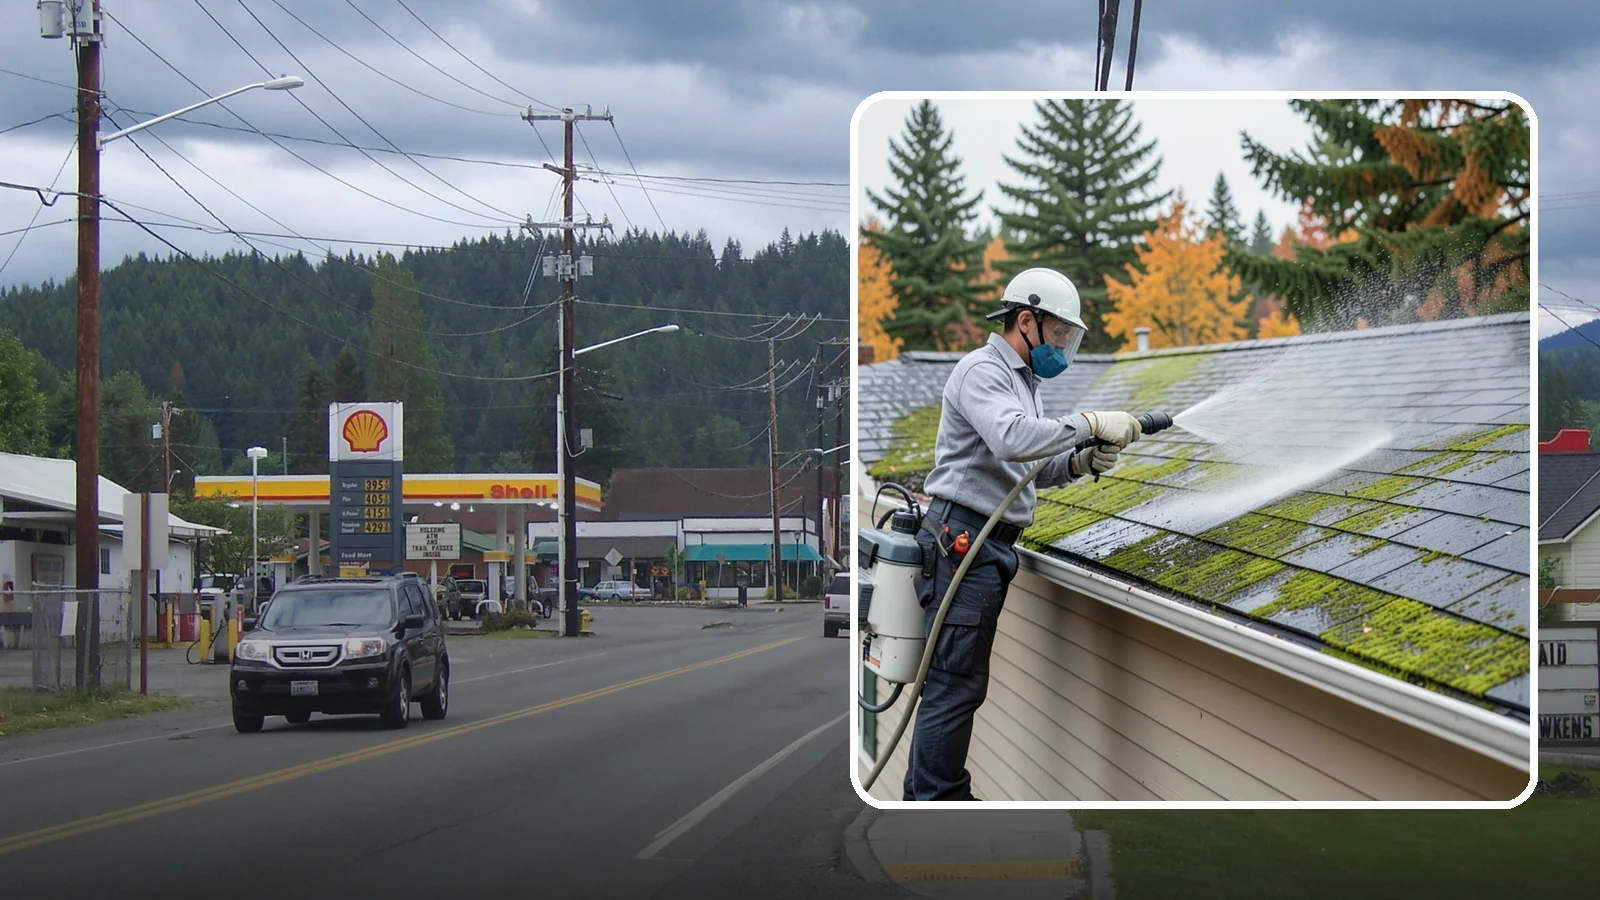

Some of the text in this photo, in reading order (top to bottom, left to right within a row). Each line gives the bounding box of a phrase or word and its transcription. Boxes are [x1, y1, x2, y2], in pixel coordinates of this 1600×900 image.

[365, 480, 383, 490] 395
[490, 484, 547, 499] Shell
[365, 494, 383, 504] 405
[365, 508, 383, 518] 415
[365, 522, 383, 533] 429
